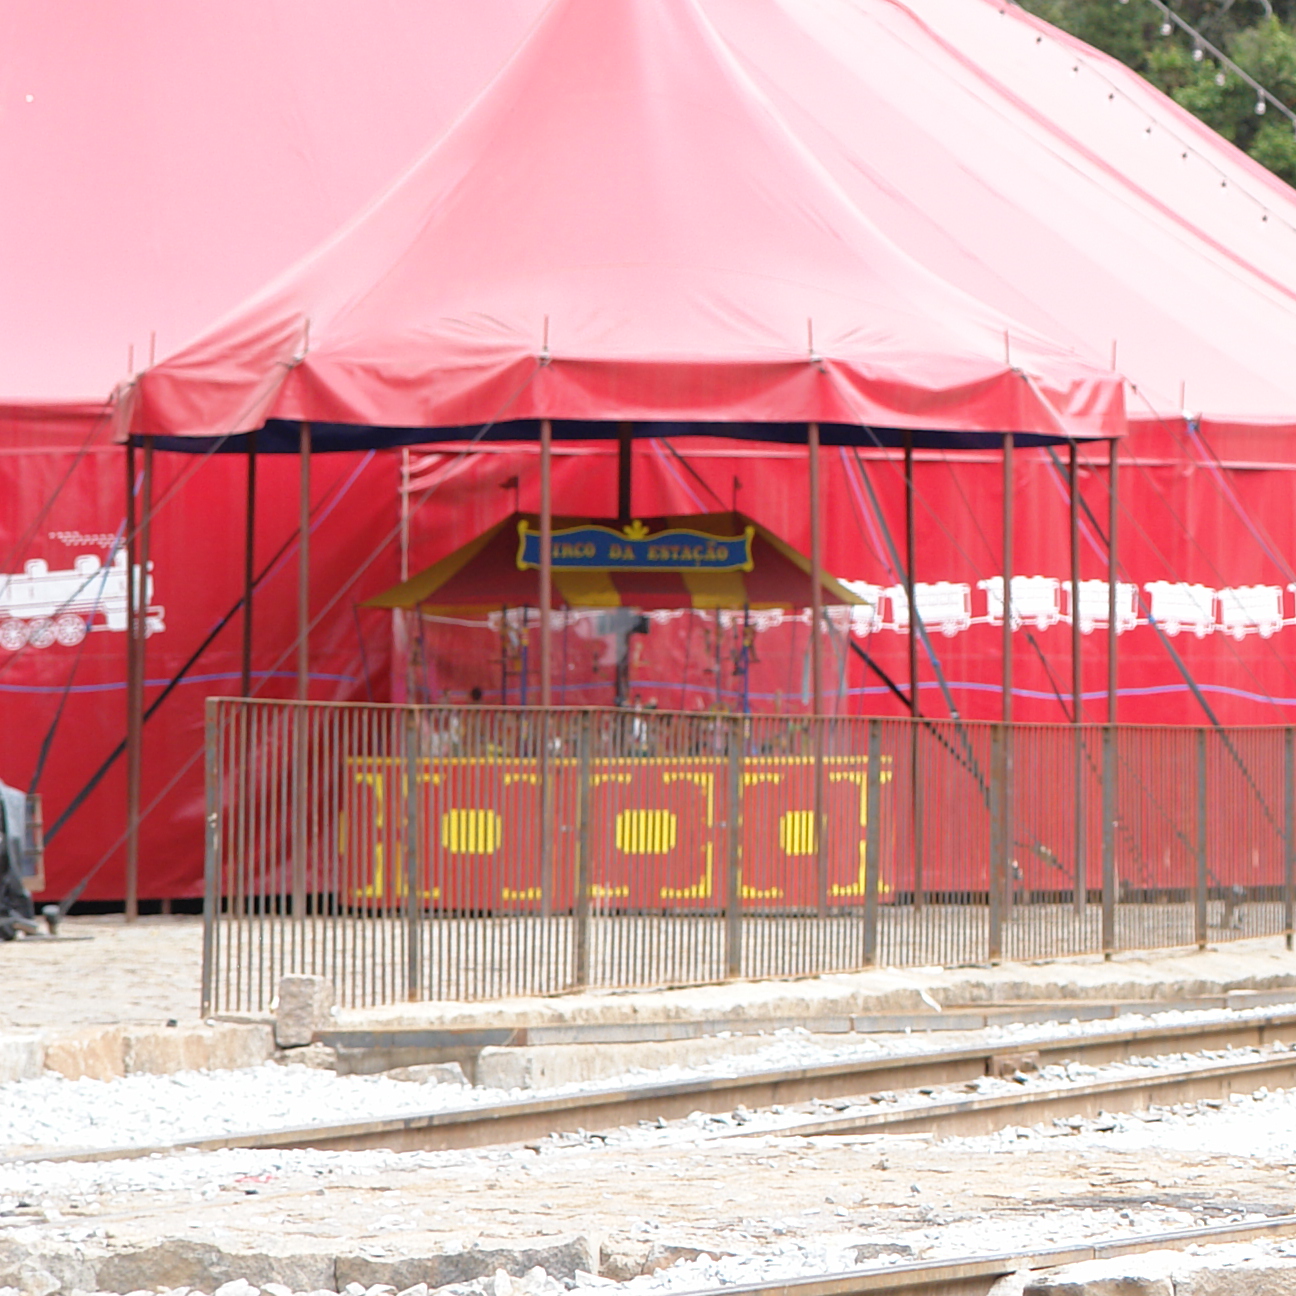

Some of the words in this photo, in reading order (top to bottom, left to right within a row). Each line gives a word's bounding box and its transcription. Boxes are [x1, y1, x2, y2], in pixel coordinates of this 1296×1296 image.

[551, 542, 596, 558] IRCO
[609, 544, 635, 560] DA
[647, 541, 729, 566] ESTAÇÃO
